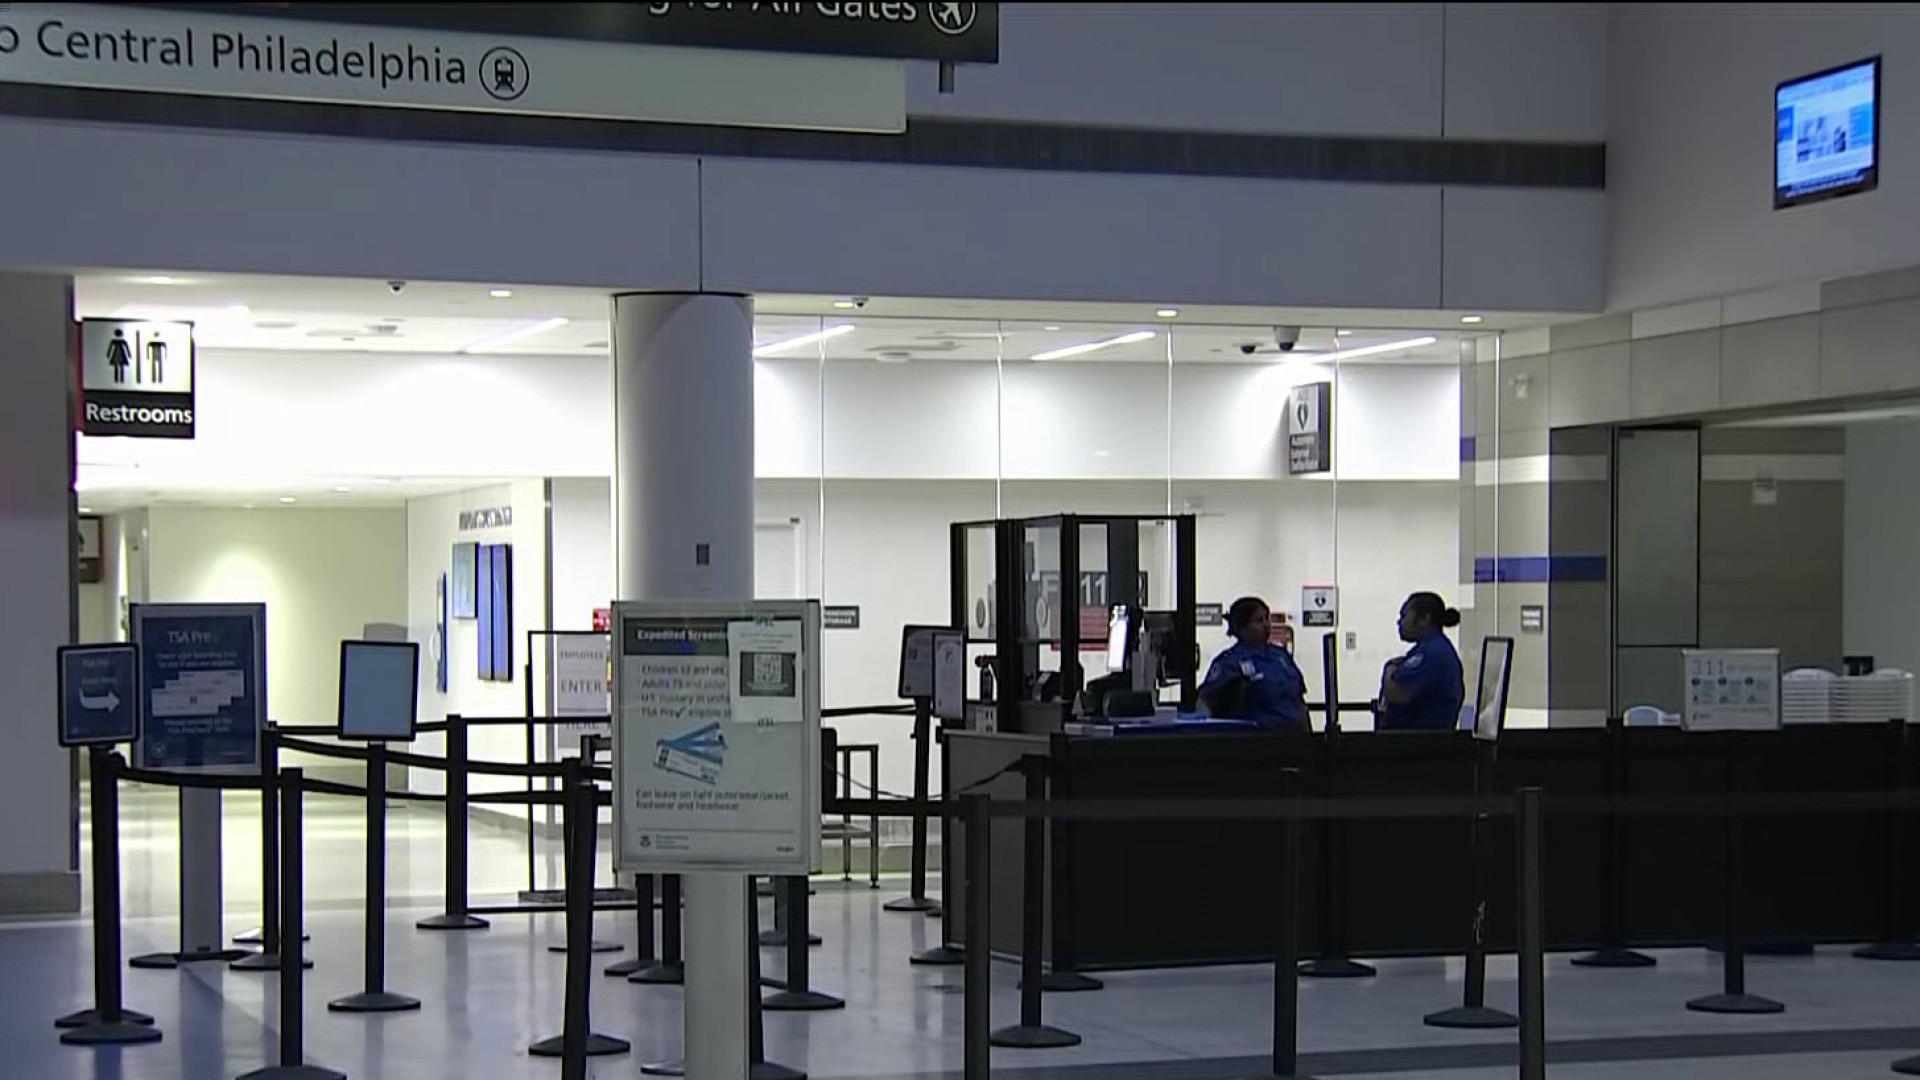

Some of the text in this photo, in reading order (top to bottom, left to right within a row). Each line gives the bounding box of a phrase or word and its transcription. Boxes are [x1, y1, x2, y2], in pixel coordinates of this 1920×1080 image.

[36, 19, 194, 68] Central
[210, 32, 466, 89] Philadelphia
[86, 402, 193, 424] Restrooms
[637, 629, 686, 642] Expedited
[560, 679, 603, 692] ENTER
[636, 789, 652, 799] Can
[654, 789, 678, 799] leave
[636, 801, 675, 810] footwear
[676, 801, 694, 810] and
